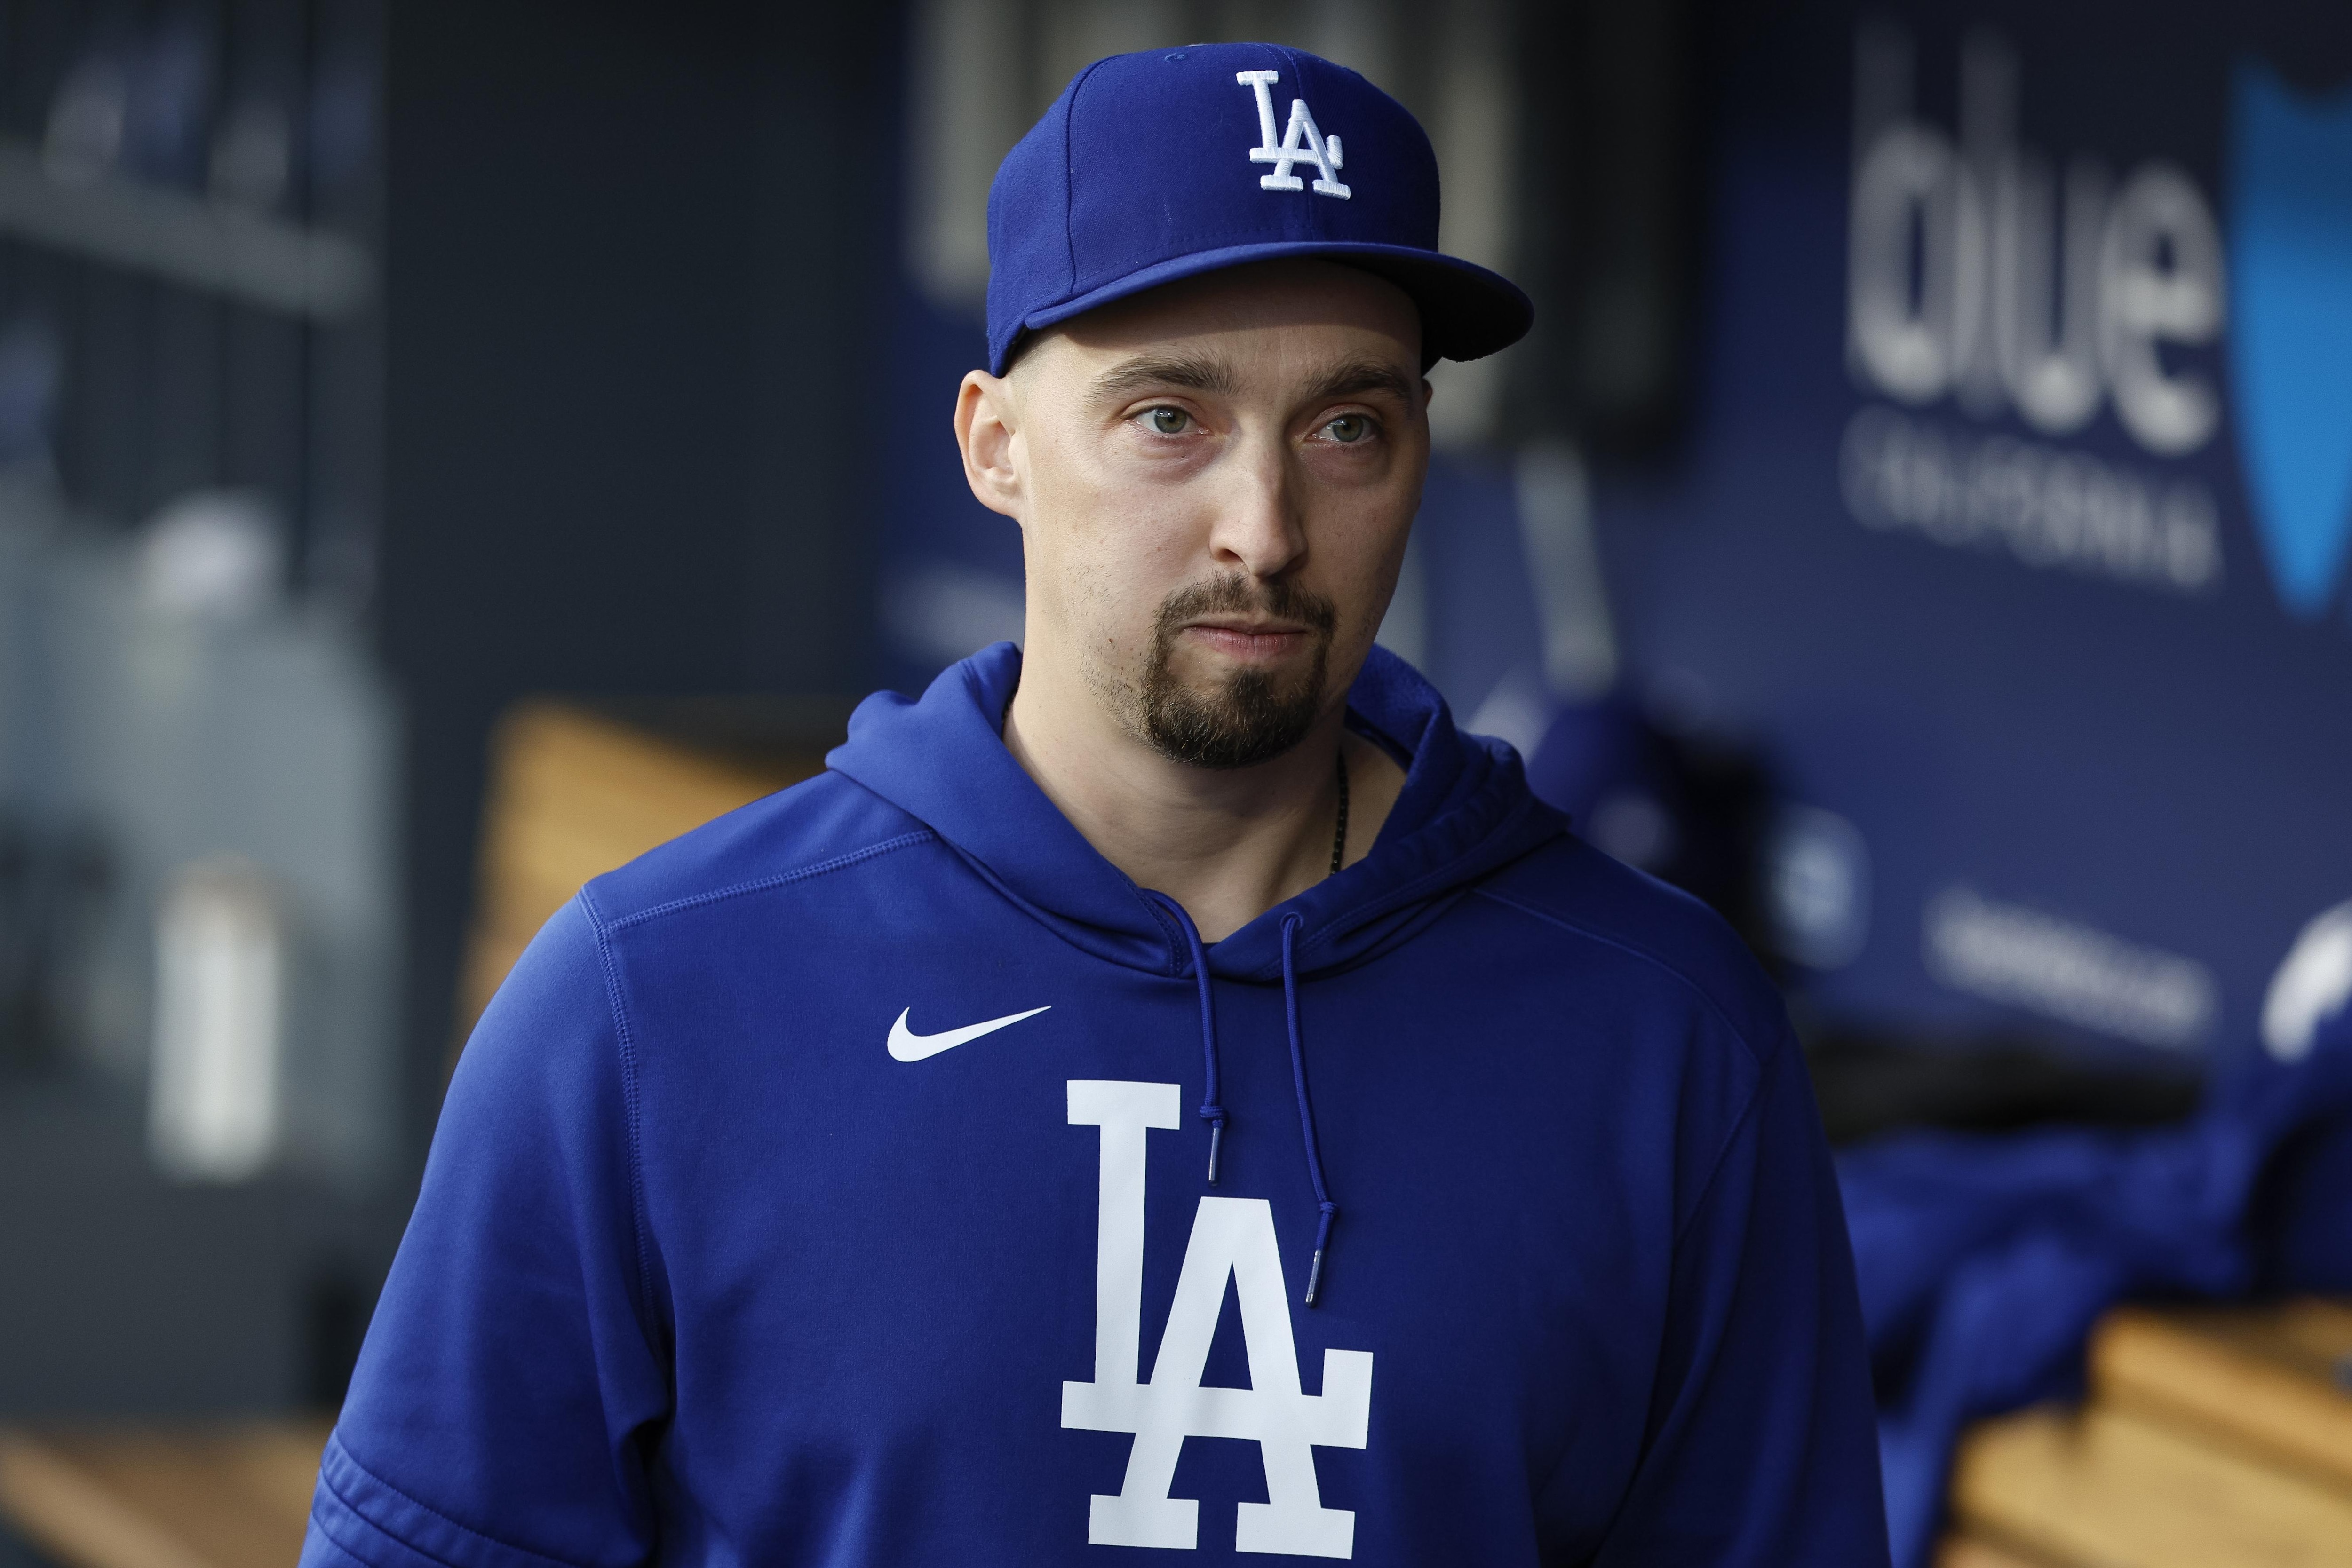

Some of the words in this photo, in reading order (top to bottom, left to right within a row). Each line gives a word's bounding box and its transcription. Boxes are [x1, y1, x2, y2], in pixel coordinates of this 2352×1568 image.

[1237, 70, 1352, 199] LA
[1846, 24, 2226, 455] blue
[1061, 1080, 1374, 1559] LA
